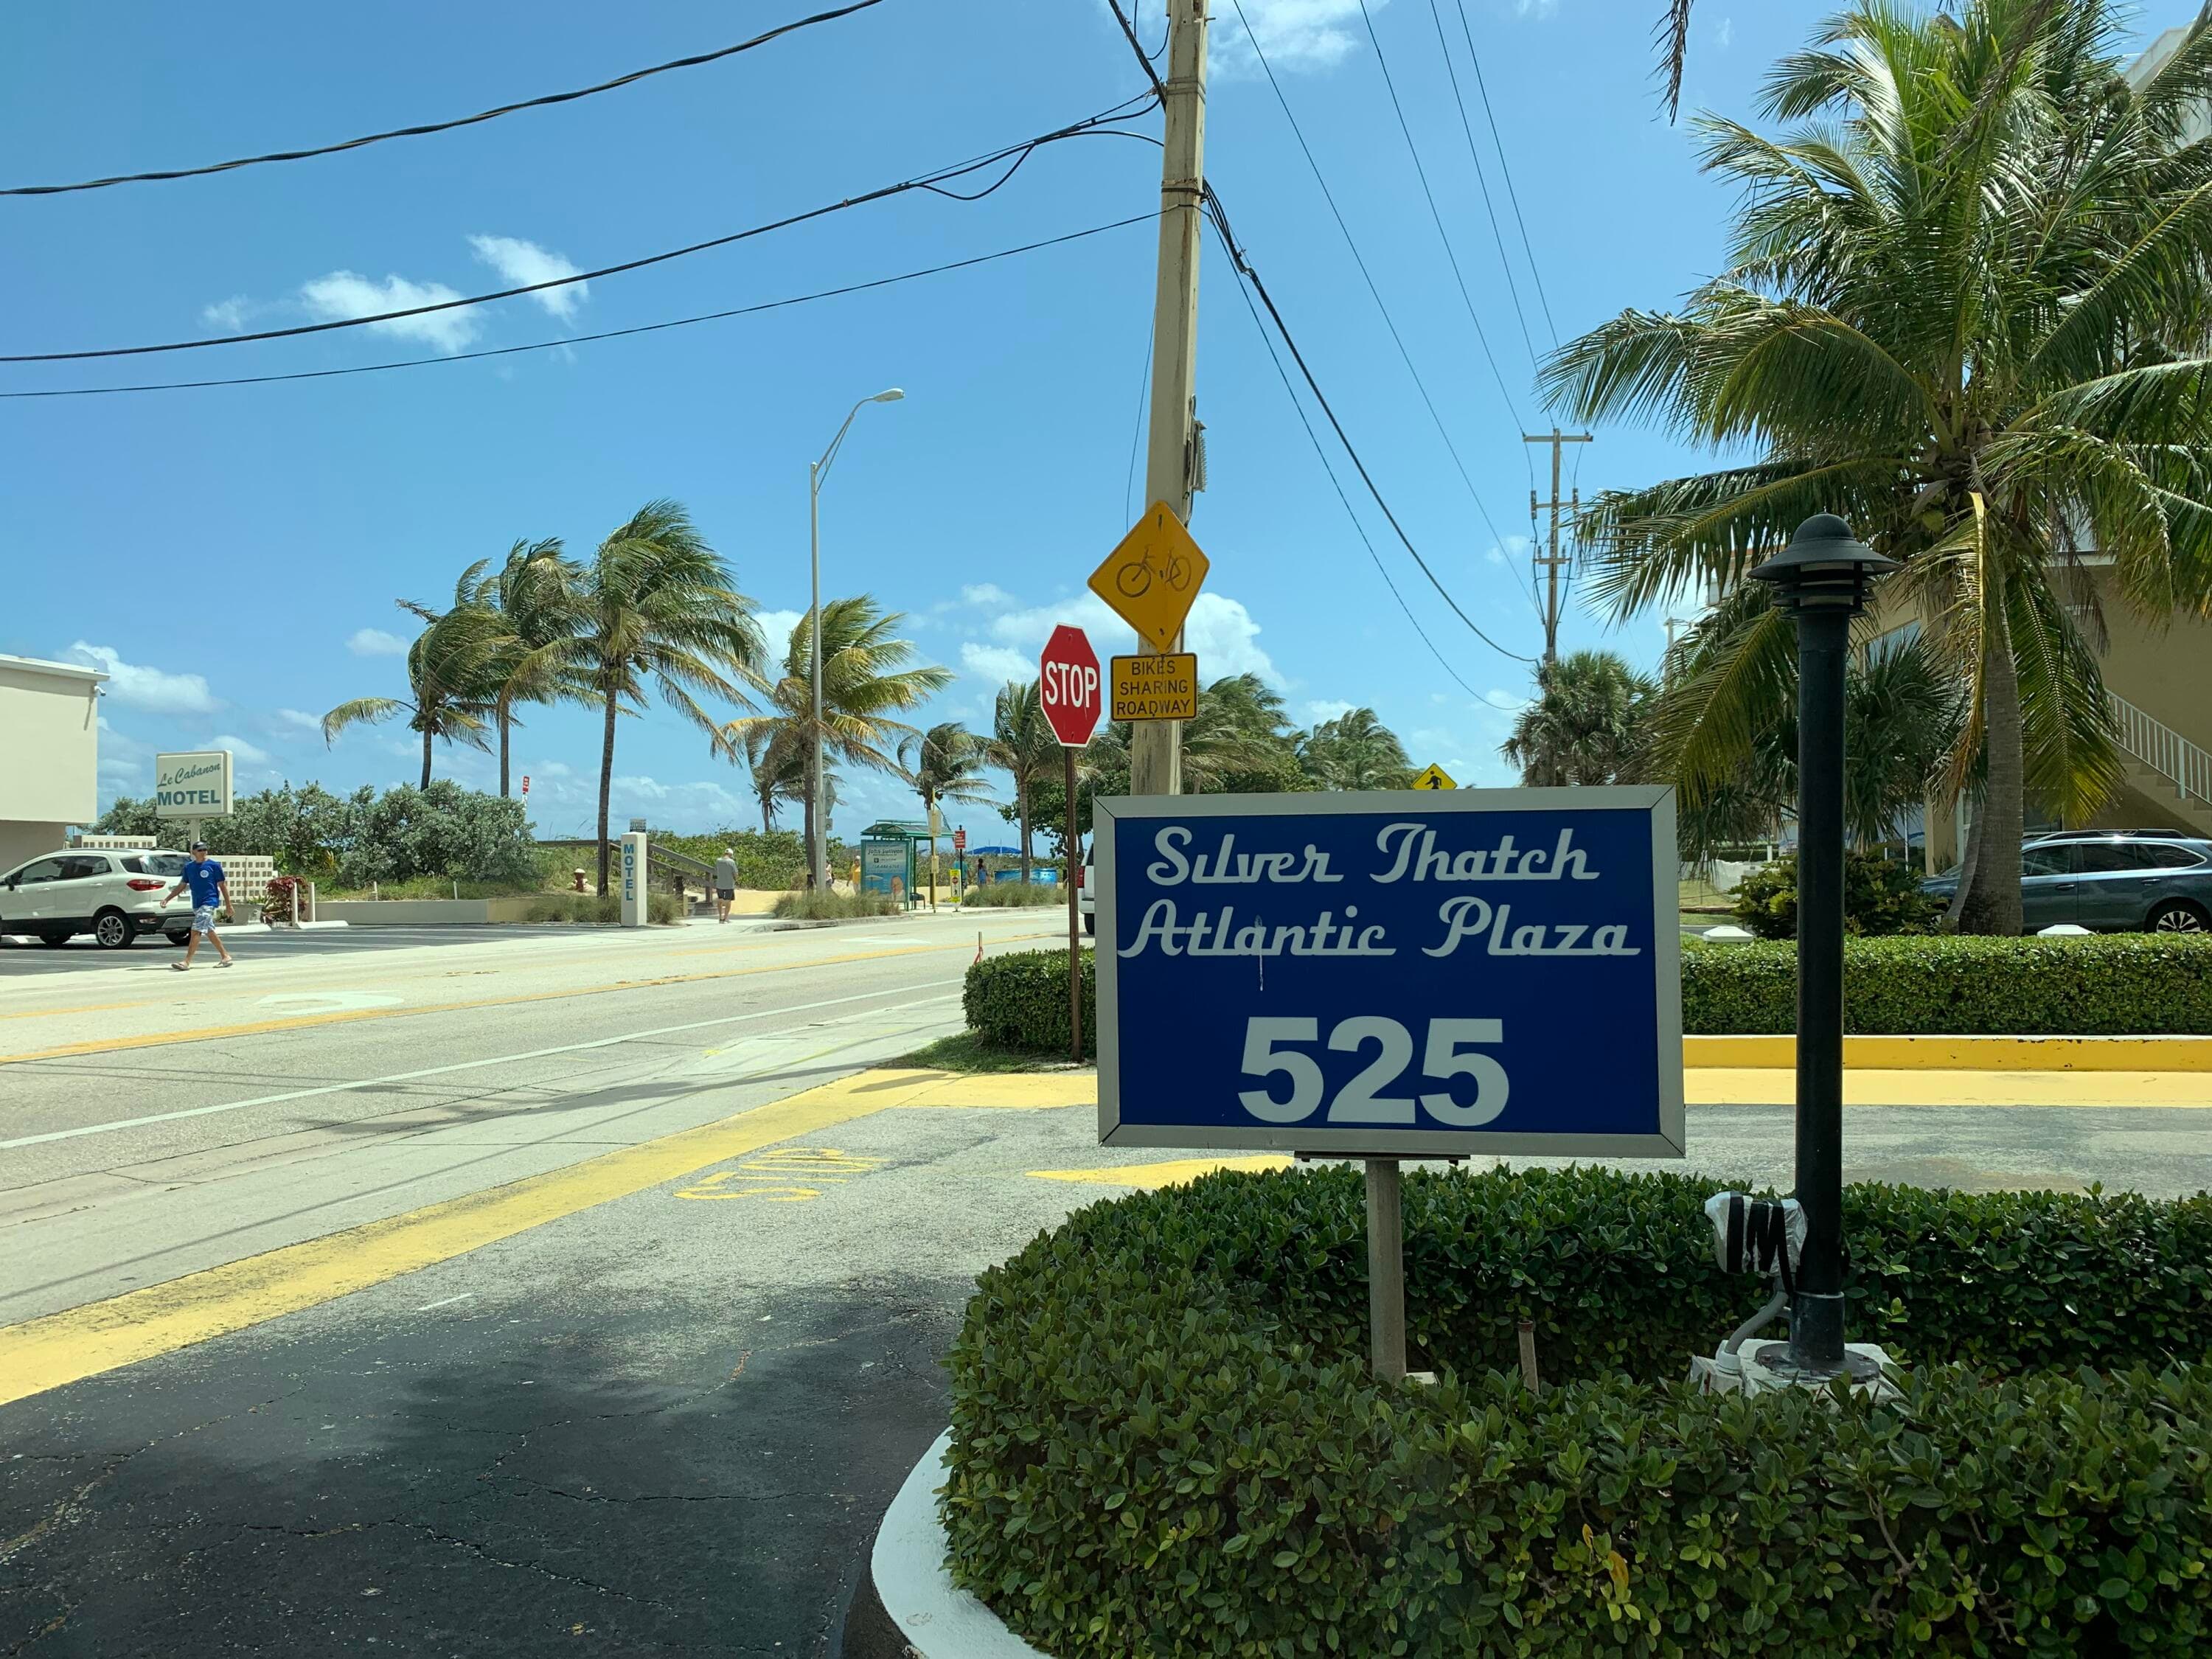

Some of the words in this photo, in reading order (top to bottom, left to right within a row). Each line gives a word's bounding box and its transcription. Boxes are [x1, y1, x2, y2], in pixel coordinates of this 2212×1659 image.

[1045, 661, 1098, 708] STOP
[1132, 660, 1176, 676] BIKES
[1119, 679, 1189, 696] SHARING
[1116, 699, 1191, 716] ROADWAY
[157, 773, 173, 787] Le
[175, 763, 220, 784] Cabanon
[157, 790, 220, 806] MOTEL
[1147, 825, 1344, 886] Silver
[1368, 822, 1601, 884] Thatch
[624, 844, 634, 901] MOTEL
[1116, 898, 1397, 959] Atlantic
[1422, 896, 1641, 958] Plaza
[1237, 1015, 1510, 1127] 525
